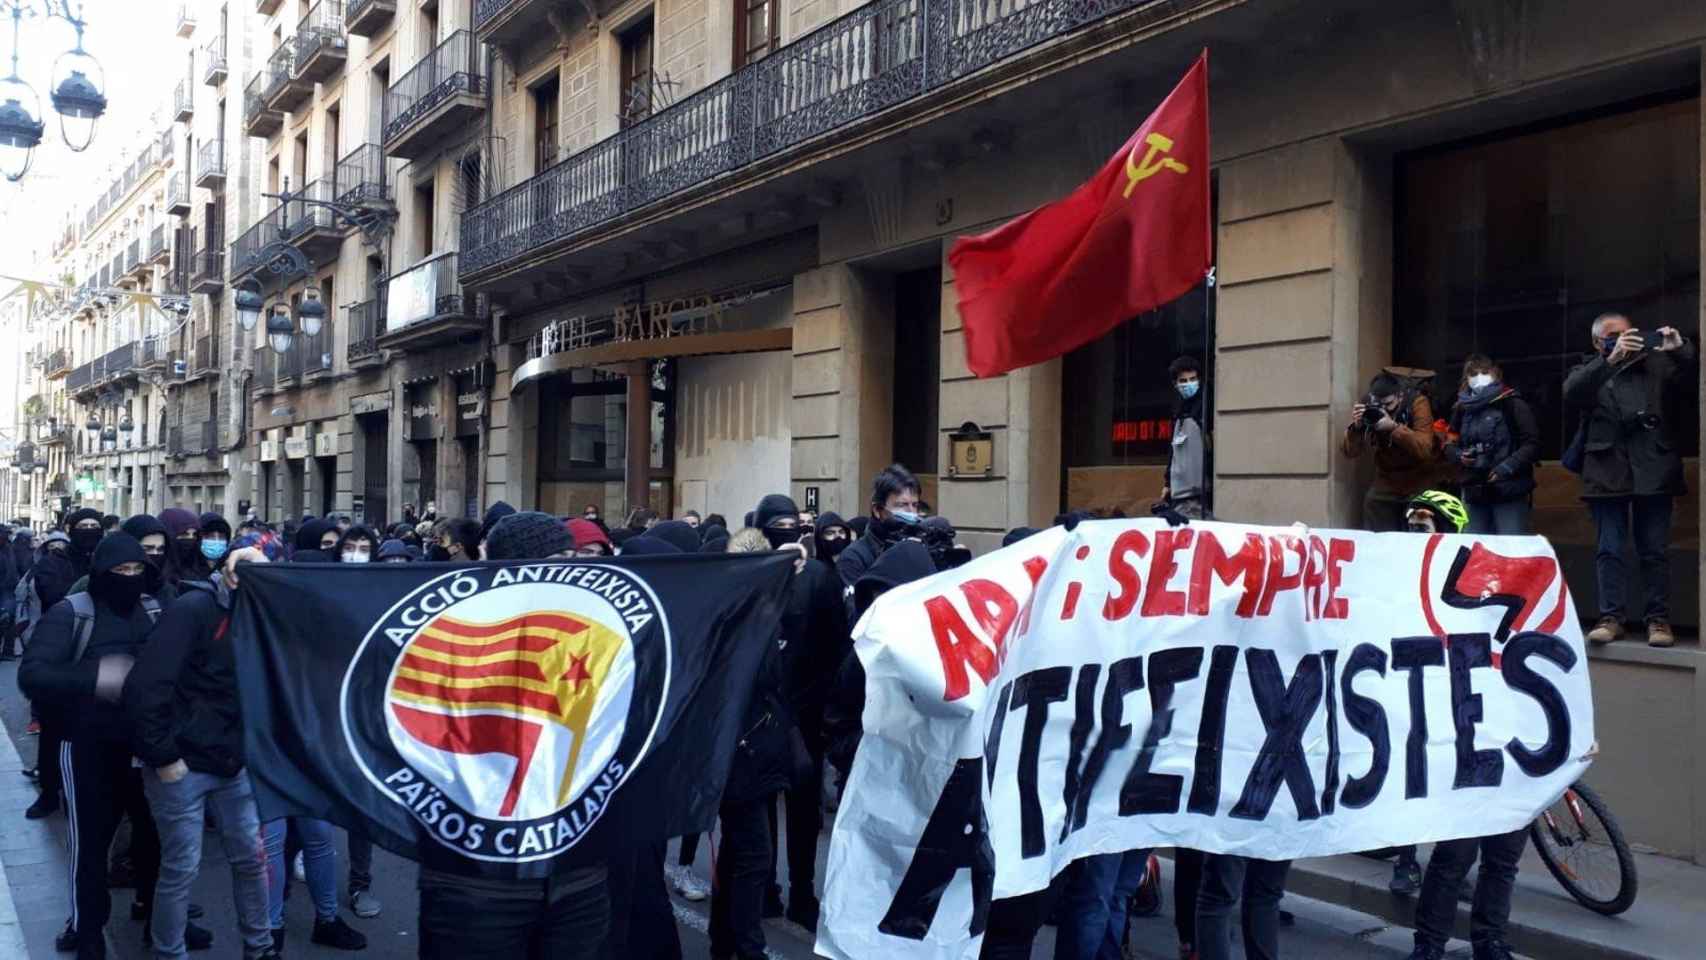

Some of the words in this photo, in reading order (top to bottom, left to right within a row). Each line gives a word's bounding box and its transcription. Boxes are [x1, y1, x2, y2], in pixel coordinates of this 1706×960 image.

[807, 488, 816, 506] H
[385, 573, 479, 649] ACCIÓ
[490, 564, 656, 634] ANTIFEIXISTA
[1103, 528, 1357, 623] SEMPRE
[385, 765, 485, 854] PAÏSOS
[494, 759, 625, 856] CATALANS
